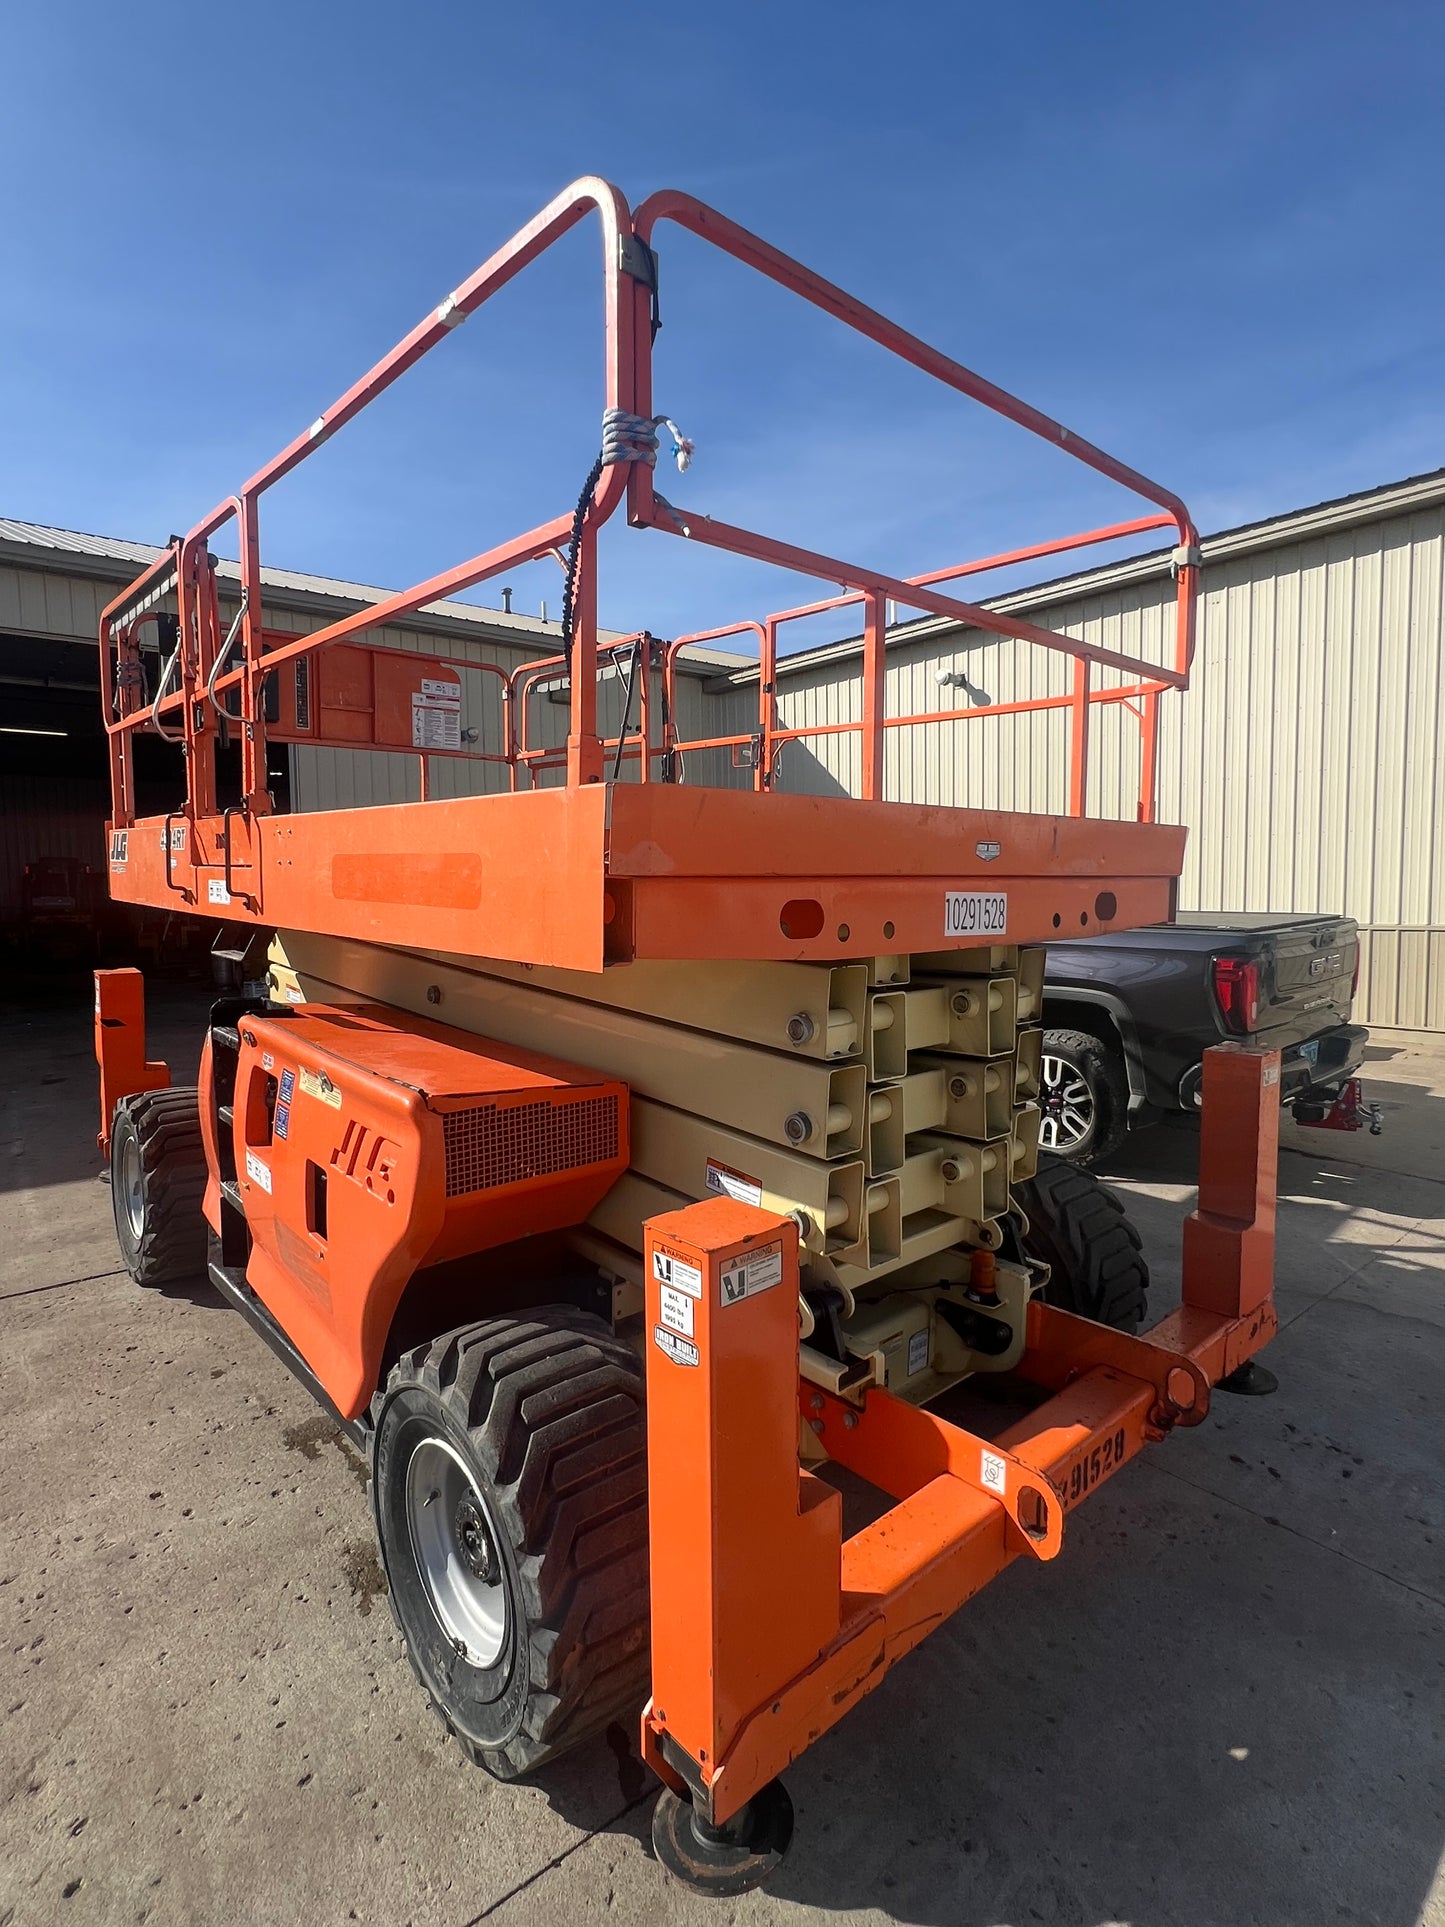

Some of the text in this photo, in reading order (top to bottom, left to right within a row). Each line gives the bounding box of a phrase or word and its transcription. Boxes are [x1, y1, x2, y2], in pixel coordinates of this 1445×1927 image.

[111, 832, 128, 861] JLG
[160, 828, 185, 850] 44RT
[945, 898, 1006, 931] 10291528
[329, 1119, 402, 1206] JLG
[739, 1244, 773, 1264] WARNING
